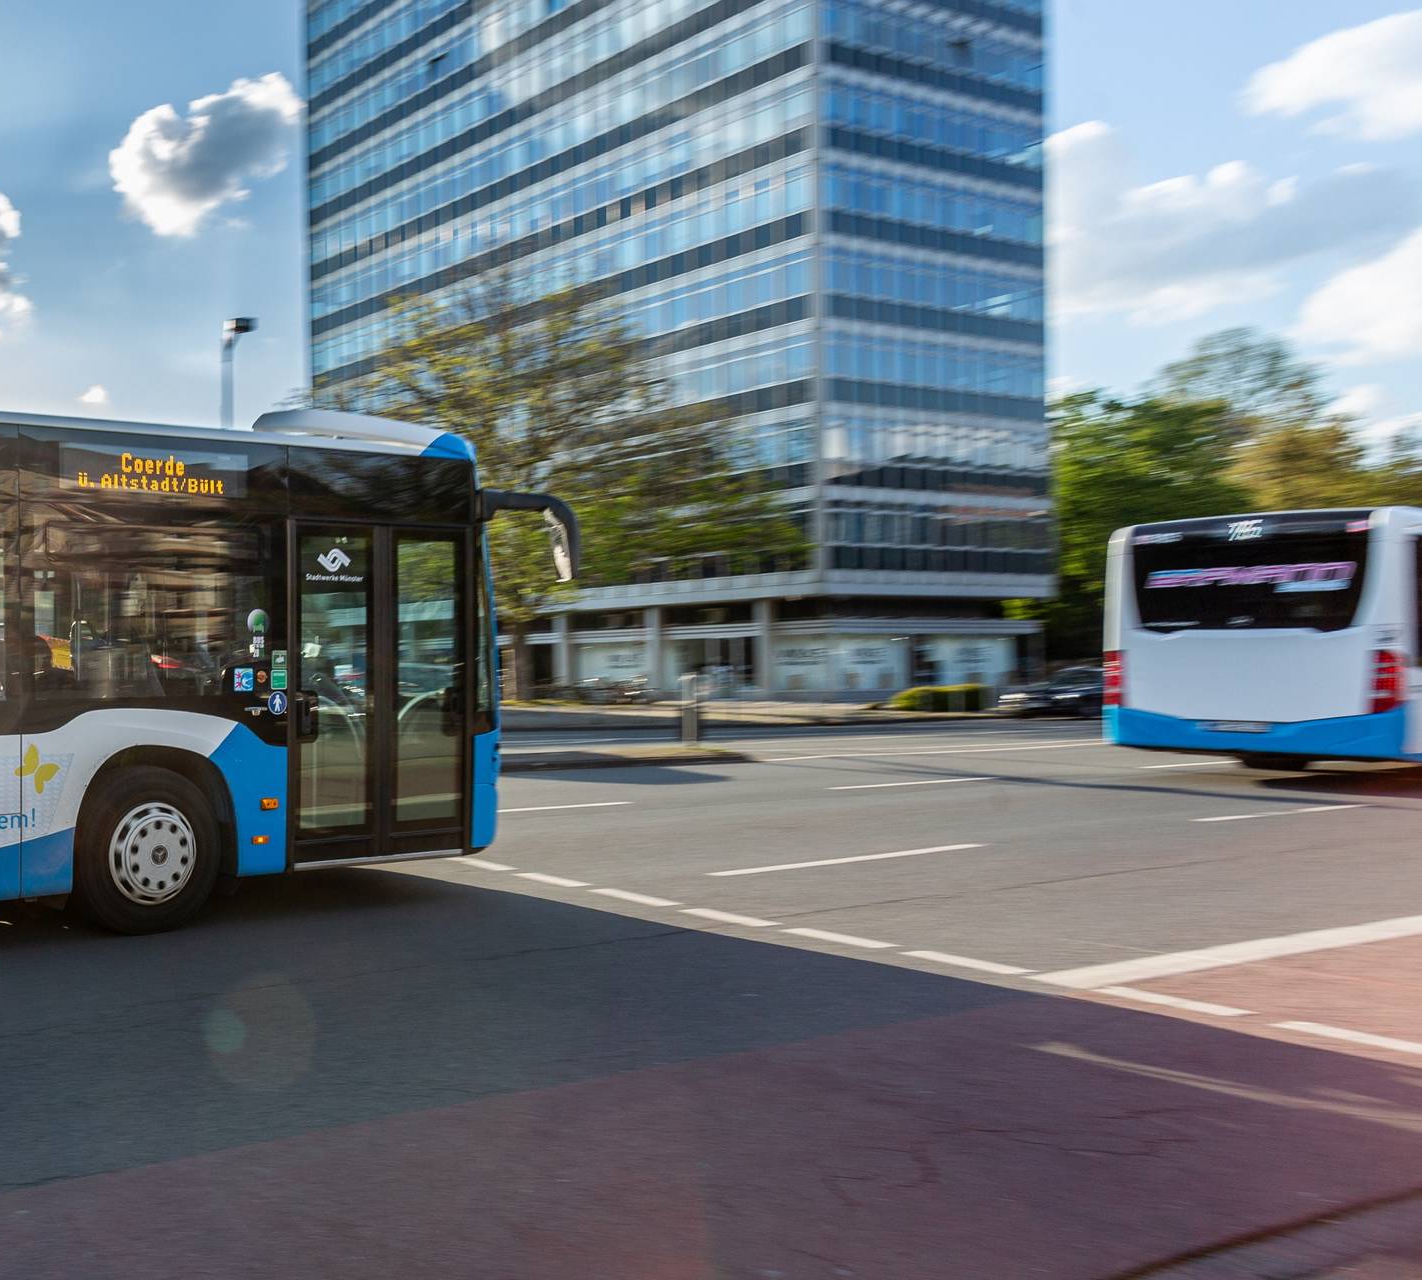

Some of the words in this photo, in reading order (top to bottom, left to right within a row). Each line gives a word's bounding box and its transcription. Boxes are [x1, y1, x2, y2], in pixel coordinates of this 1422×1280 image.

[121, 452, 185, 476] Coerde
[78, 472, 95, 488] ü.
[101, 473, 224, 495] Altstadt/Bült
